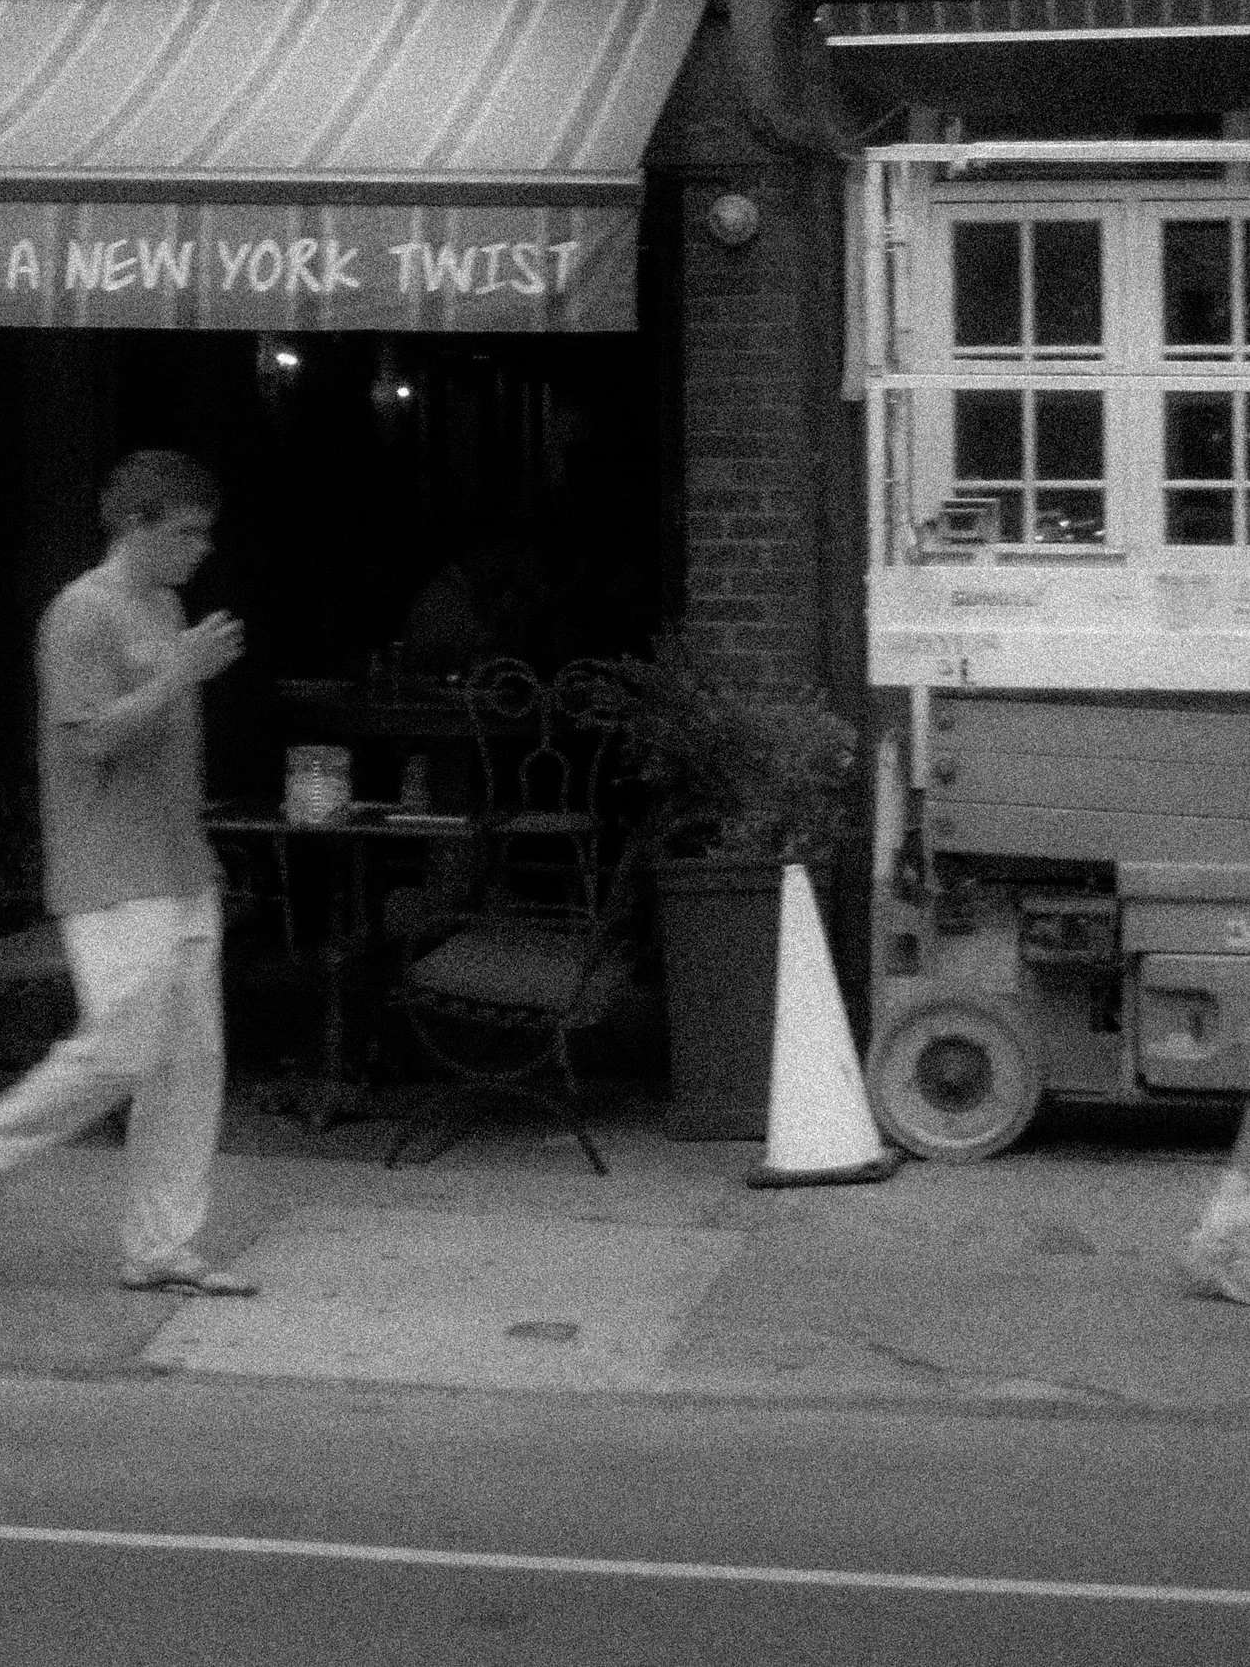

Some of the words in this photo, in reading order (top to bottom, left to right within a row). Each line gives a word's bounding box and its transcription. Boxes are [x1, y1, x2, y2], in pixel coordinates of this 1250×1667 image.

[8, 237, 41, 291] A
[66, 238, 197, 293] NEW
[217, 238, 361, 294] YORK
[388, 240, 580, 297] TWIST
